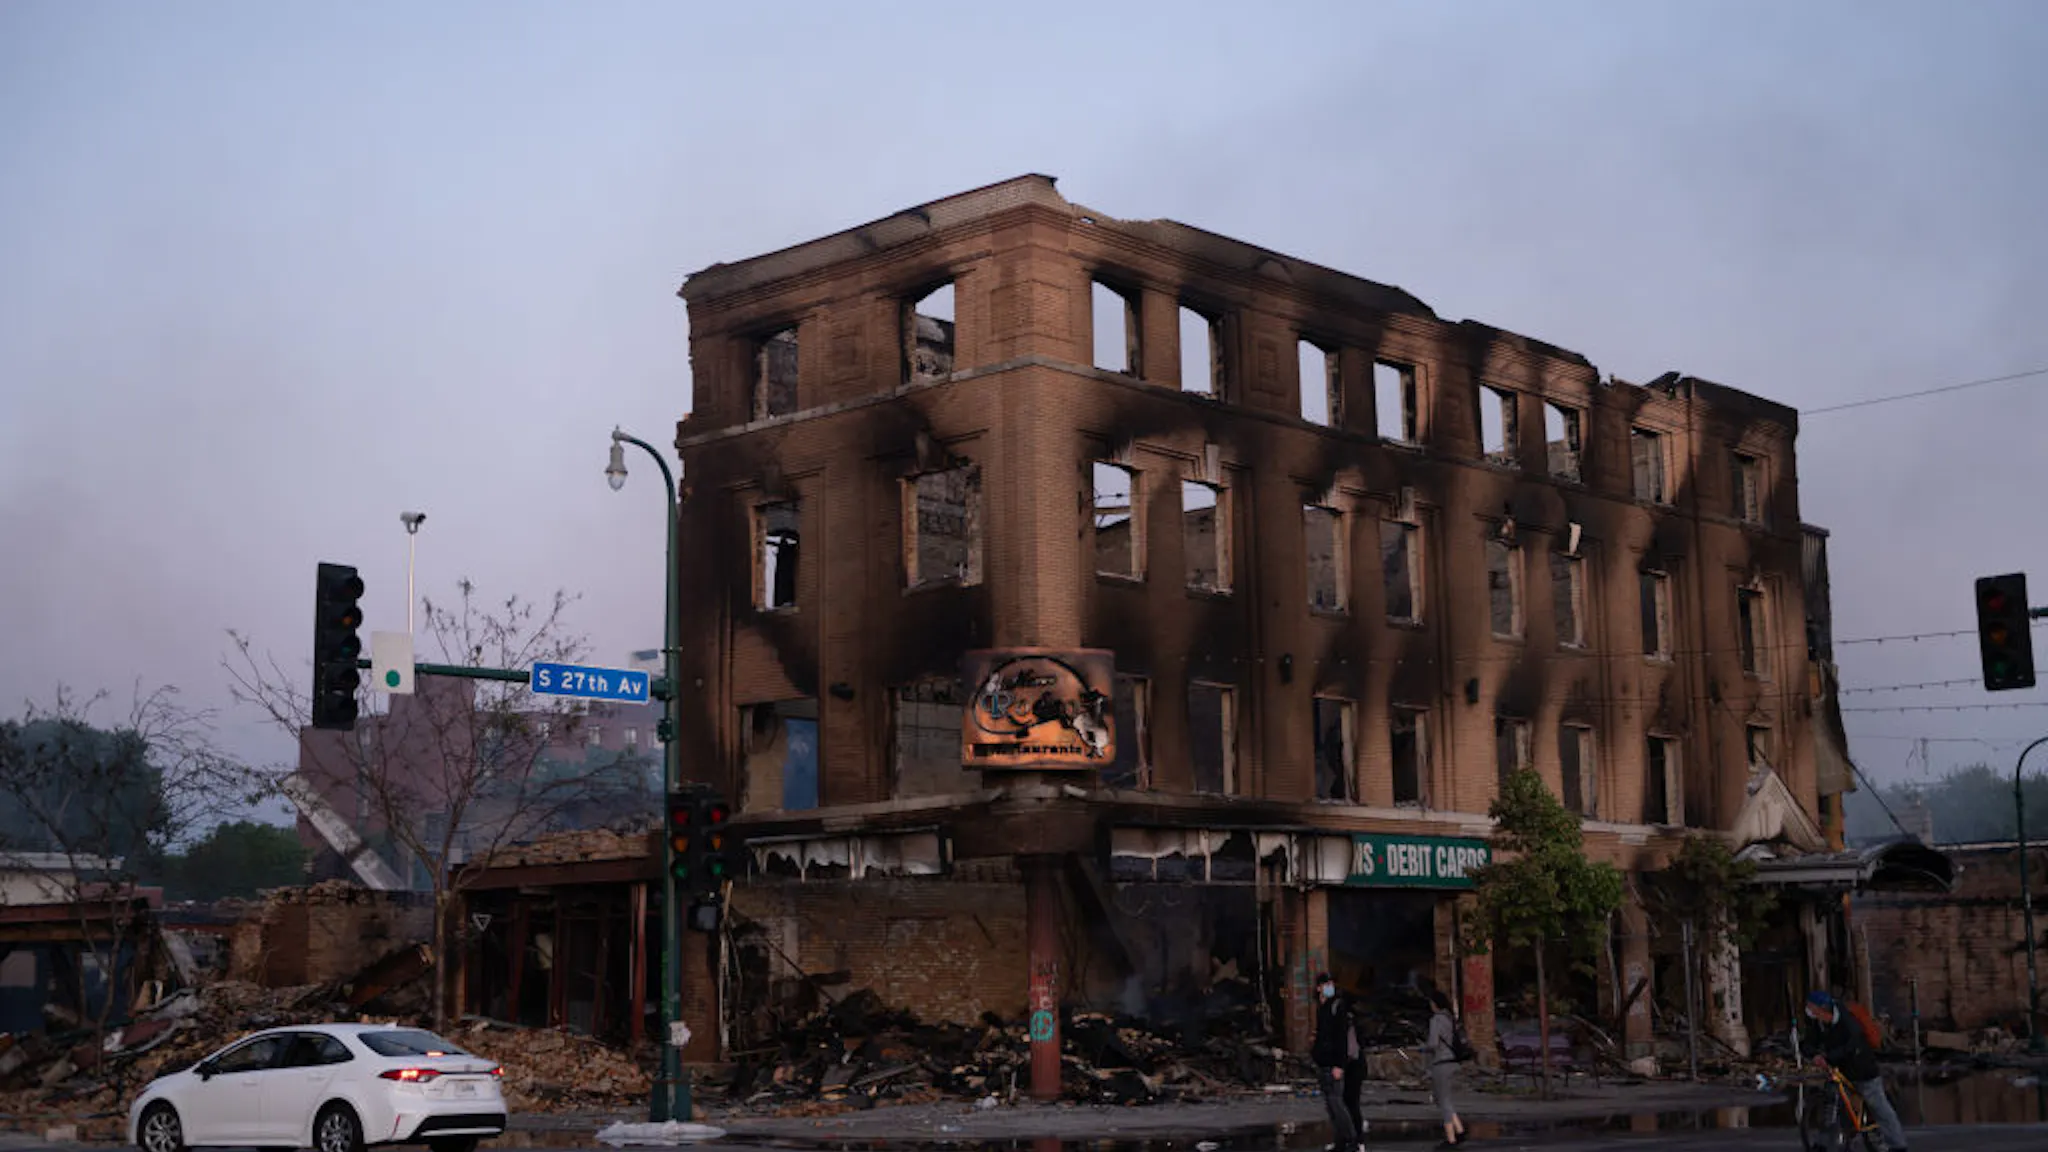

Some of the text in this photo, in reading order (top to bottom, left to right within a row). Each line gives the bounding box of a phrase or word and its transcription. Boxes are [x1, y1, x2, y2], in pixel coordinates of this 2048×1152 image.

[539, 669, 642, 695] S 27th Av
[1386, 844, 1432, 877] DEBIT
[1436, 846, 1487, 879] CARDS
